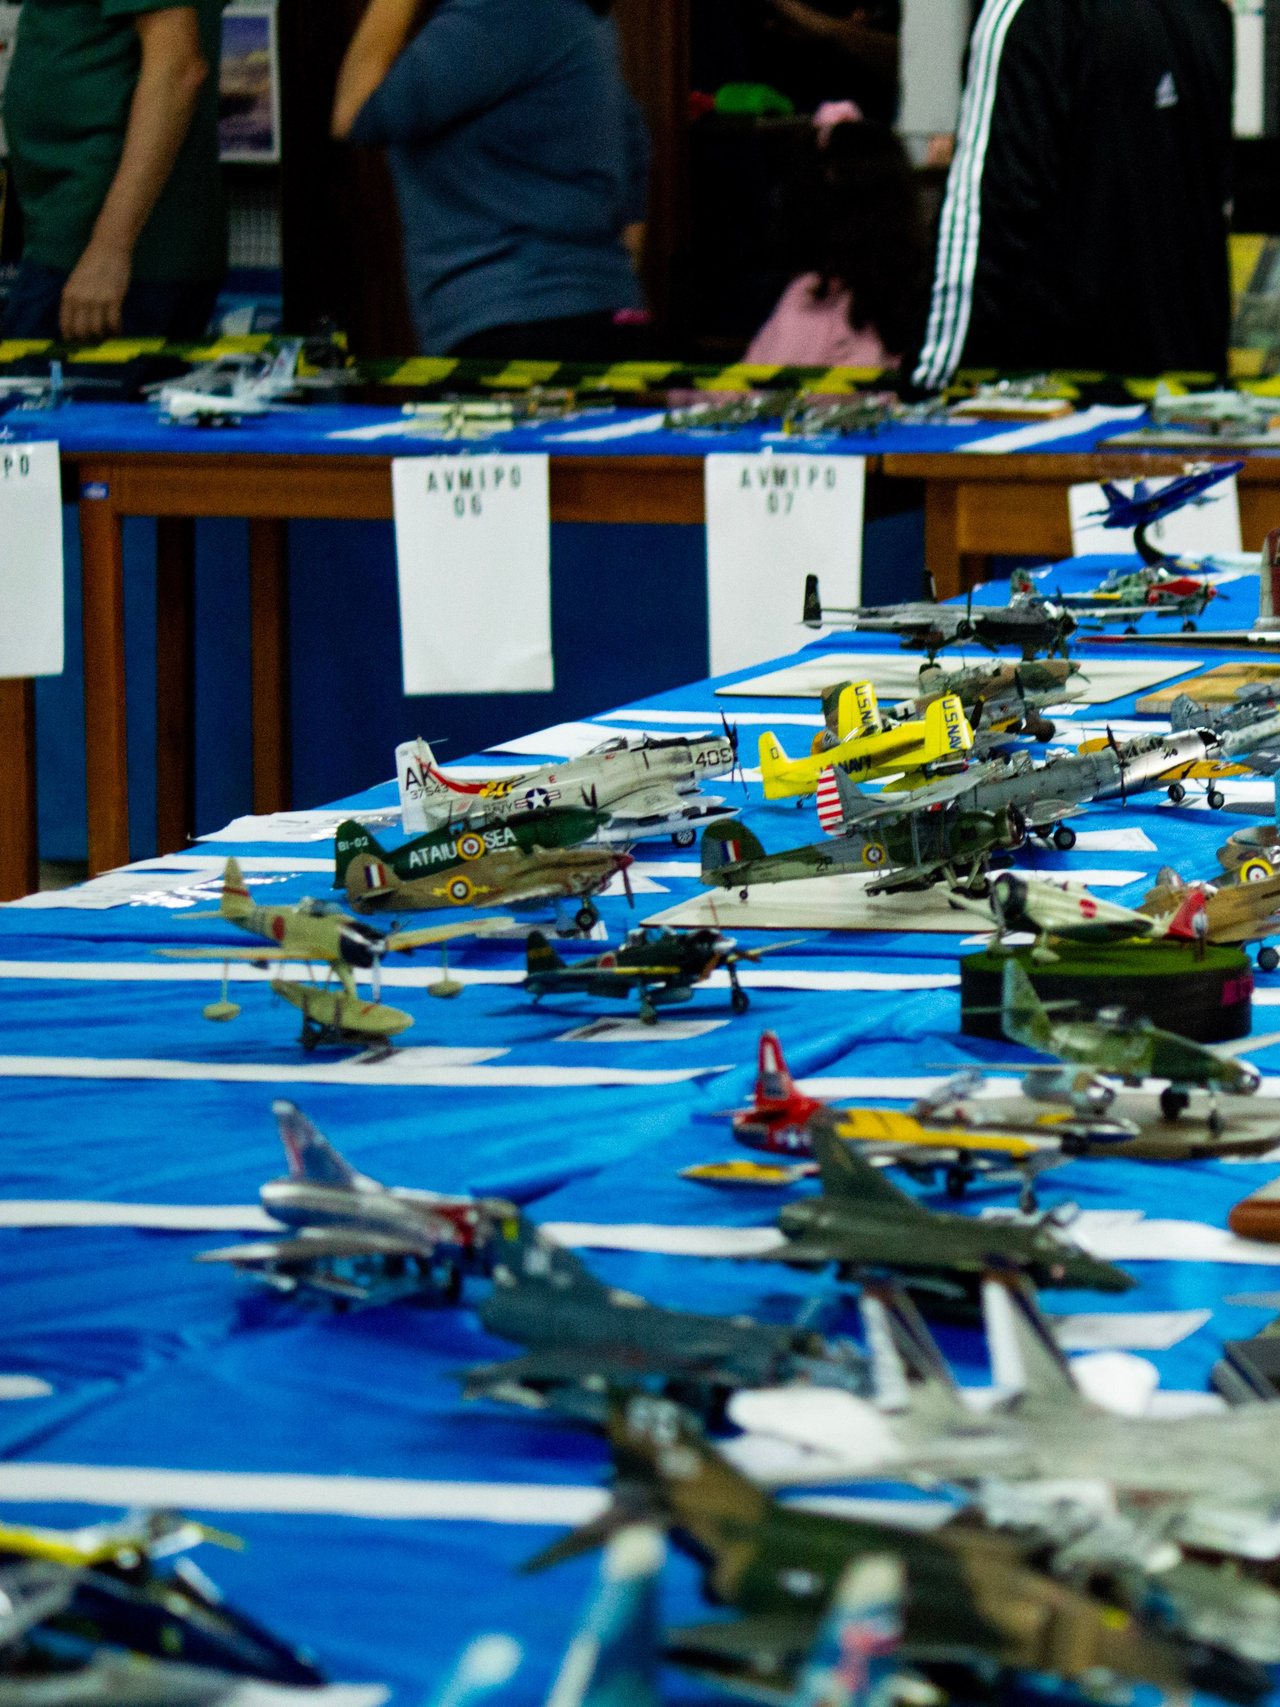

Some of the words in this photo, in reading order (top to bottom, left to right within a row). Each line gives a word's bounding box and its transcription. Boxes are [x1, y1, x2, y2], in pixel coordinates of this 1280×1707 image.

[427, 464, 521, 493] AVMIPO
[740, 465, 836, 489] AVMIPO
[453, 493, 482, 518] 06
[766, 490, 794, 516] 07
[405, 761, 437, 791] AK
[482, 826, 518, 850] SEA
[409, 840, 458, 869] ATAIU
